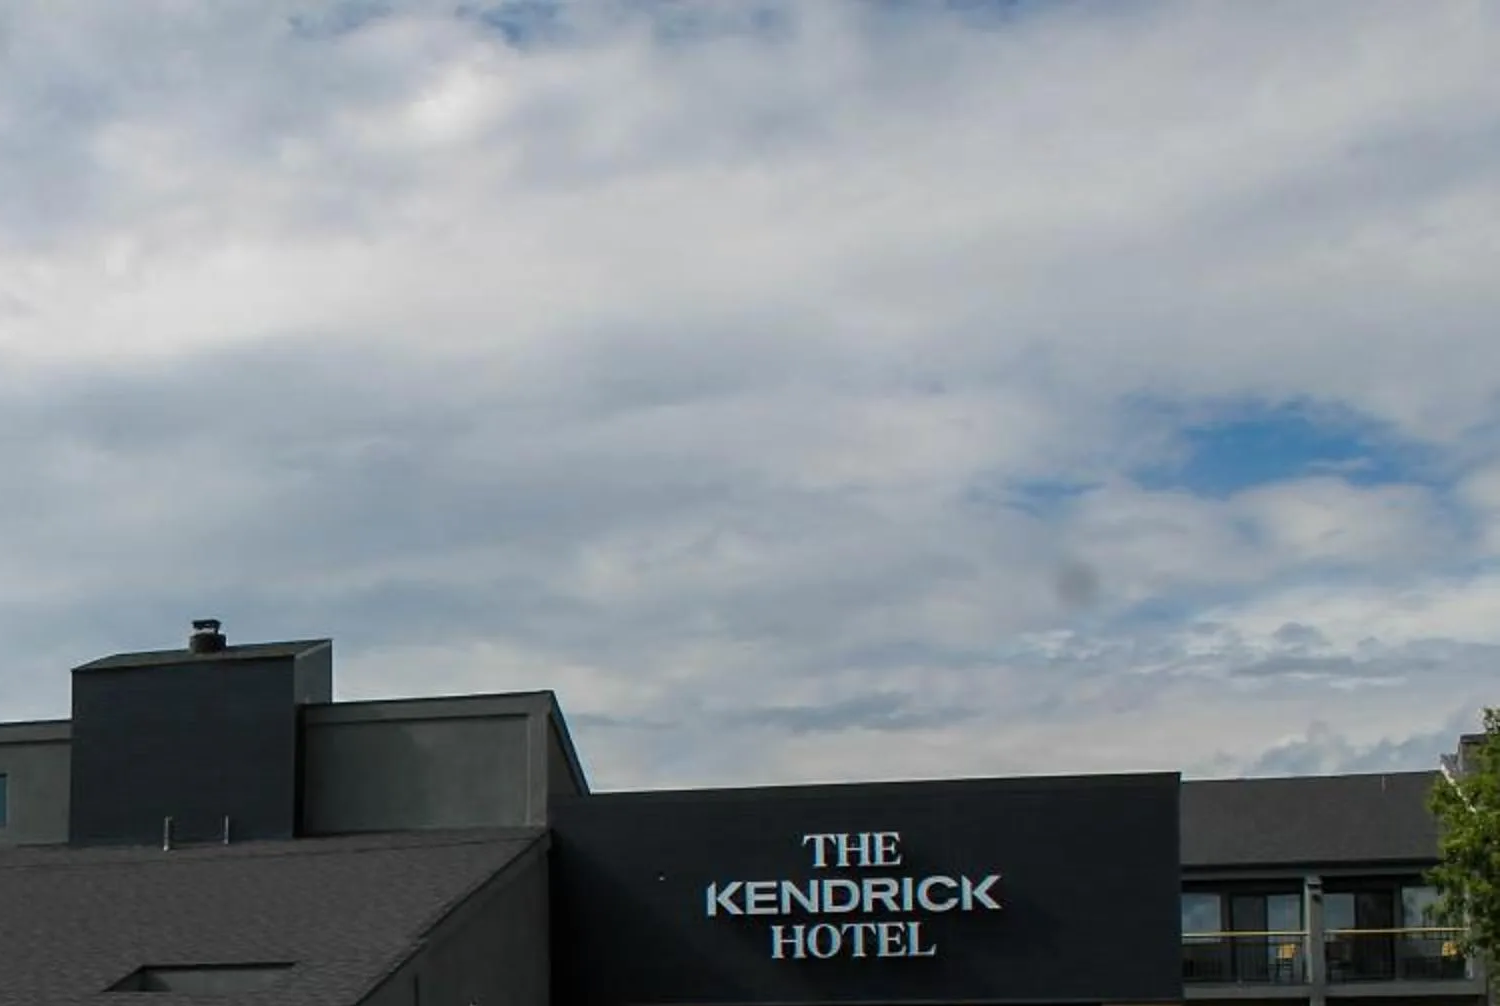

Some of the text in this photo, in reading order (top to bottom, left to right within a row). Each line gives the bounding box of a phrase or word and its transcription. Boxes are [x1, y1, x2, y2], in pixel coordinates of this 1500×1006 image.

[802, 831, 902, 868] THE
[706, 875, 1001, 916] KENDRICK
[771, 921, 937, 959] HOTEL
